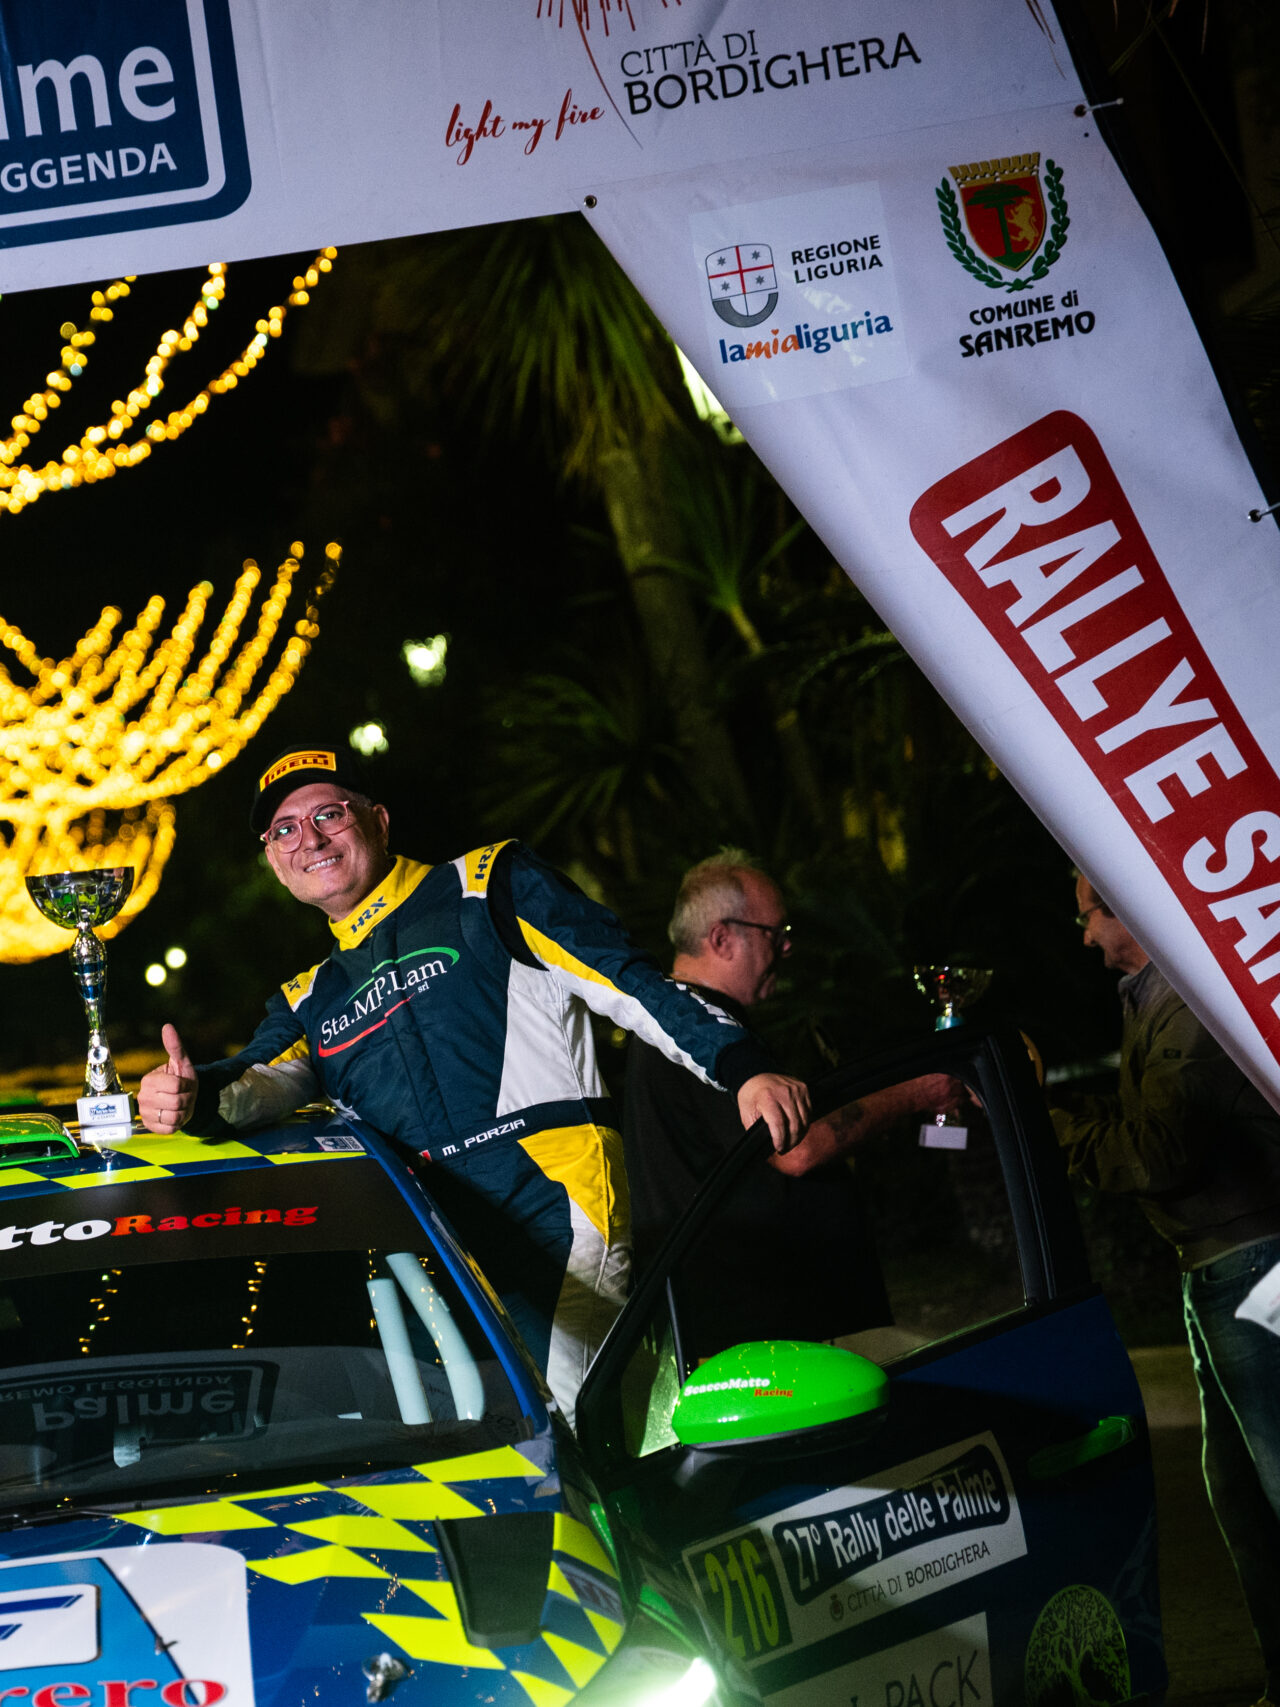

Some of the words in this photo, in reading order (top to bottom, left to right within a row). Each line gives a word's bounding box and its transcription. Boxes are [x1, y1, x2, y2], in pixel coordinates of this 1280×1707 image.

[620, 33, 715, 77] CITTÀ
[723, 30, 757, 60] DI
[624, 32, 921, 115] BORDIGHERA
[445, 100, 505, 166] light
[512, 117, 550, 156] my
[555, 88, 604, 141] fire
[791, 234, 881, 265] REGIONE
[794, 254, 883, 284] LIGURIA
[969, 294, 1055, 326] COMUNE
[1061, 290, 1079, 309] di
[959, 311, 1095, 358] SANREMO
[940, 444, 1248, 825] RALLYE
[265, 754, 329, 787] PIRELLI
[350, 895, 388, 935] HRX
[418, 982, 430, 993] srl
[442, 1144, 460, 1157] M.
[464, 1119, 526, 1149] PORZIA
[684, 1378, 770, 1397] ScaccoMatto
[754, 1388, 794, 1397] Racing
[824, 1503, 883, 1569] Rally
[885, 1492, 934, 1541] delle
[932, 1467, 1002, 1524] Palme
[847, 1579, 887, 1612] CITTÀ
[887, 1577, 903, 1596] DI
[905, 1540, 991, 1588] BORDIGHERA
[704, 1538, 780, 1659] 216
